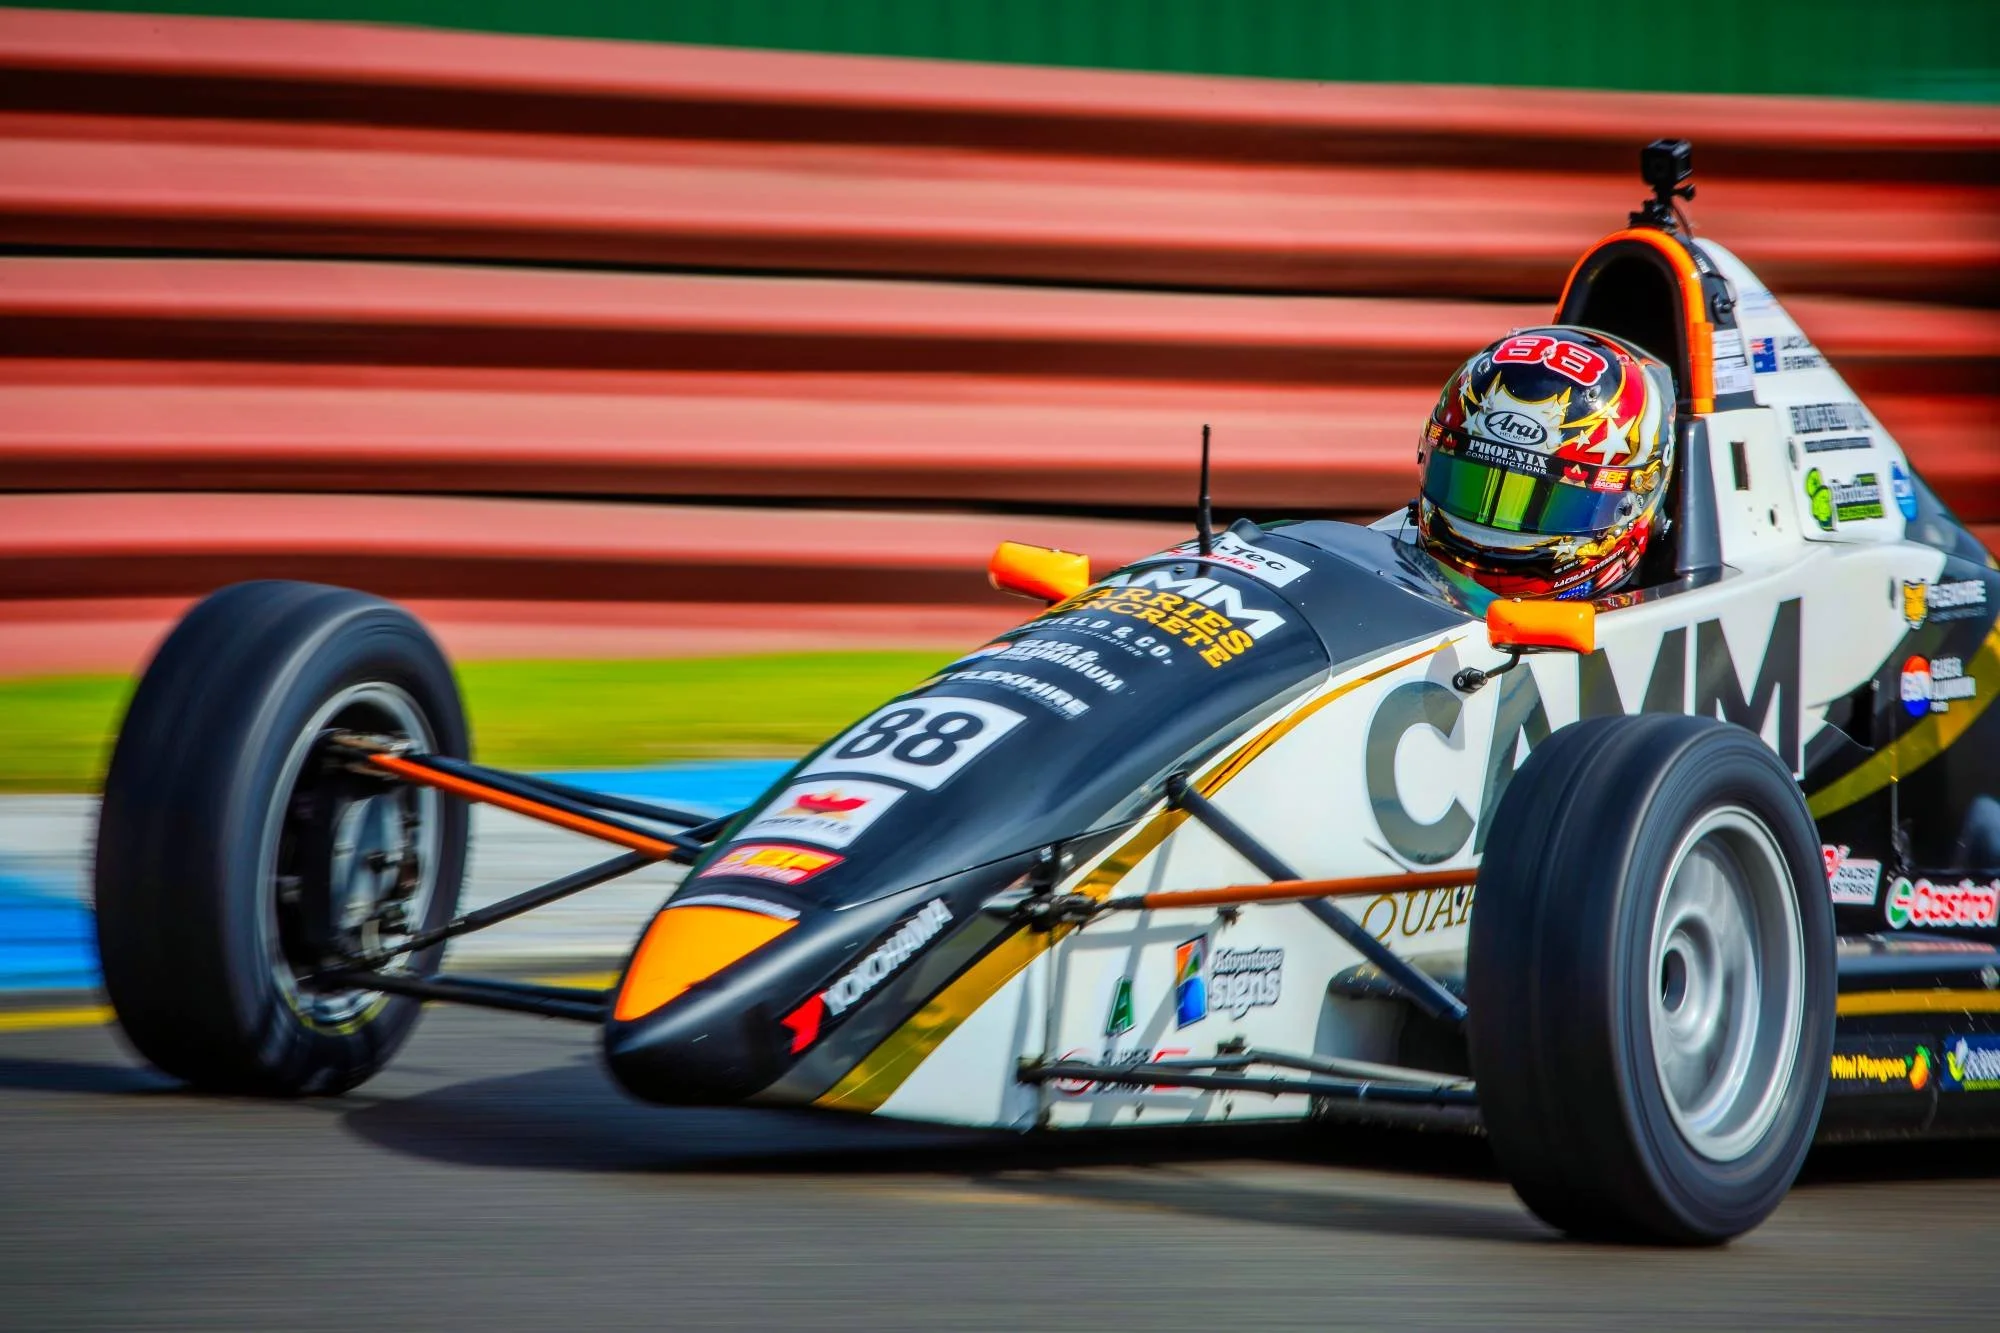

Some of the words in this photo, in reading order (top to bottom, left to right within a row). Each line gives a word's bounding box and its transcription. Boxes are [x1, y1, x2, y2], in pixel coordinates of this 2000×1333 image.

[1492, 336, 1608, 386] 88
[1488, 414, 1541, 439] Arai
[1466, 451, 1547, 474] CONSTRUCTIONS
[1468, 440, 1550, 468] PHOENIX
[1112, 626, 1134, 639] &
[1134, 636, 1173, 665] CO.
[834, 708, 984, 766] 88
